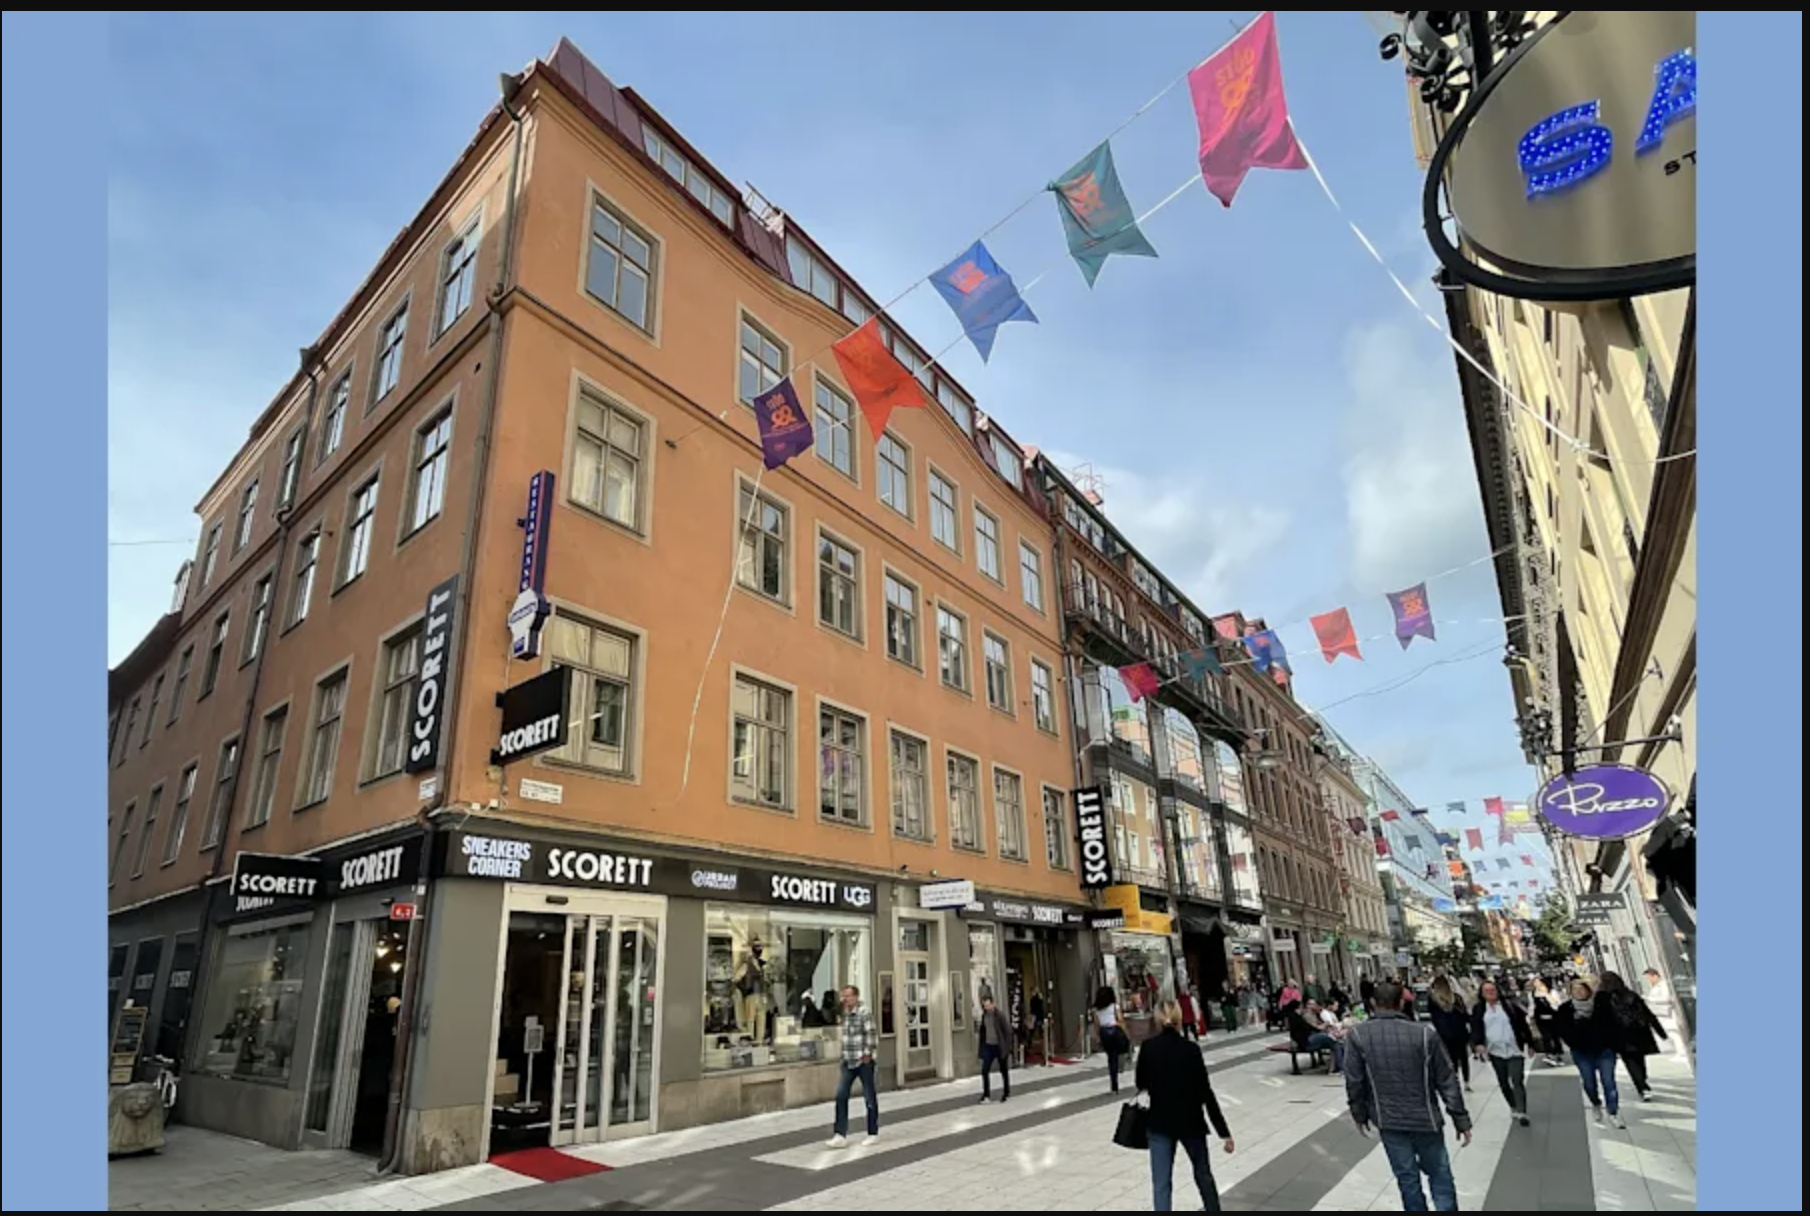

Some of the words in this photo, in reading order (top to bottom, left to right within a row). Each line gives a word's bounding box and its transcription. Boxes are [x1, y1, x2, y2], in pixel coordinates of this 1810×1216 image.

[411, 590, 450, 762] SCORETT
[500, 713, 560, 756] SCORETT
[461, 835, 531, 861] SNEAKERS
[1077, 792, 1108, 883] SCORETT
[340, 846, 404, 889] SCORETT
[468, 855, 522, 878] CORNER
[547, 848, 653, 886] SCORETT
[239, 873, 317, 896] SCORETT
[771, 875, 836, 903] SCORETT
[843, 886, 871, 907] UGG
[1580, 900, 1623, 908] ZARA
